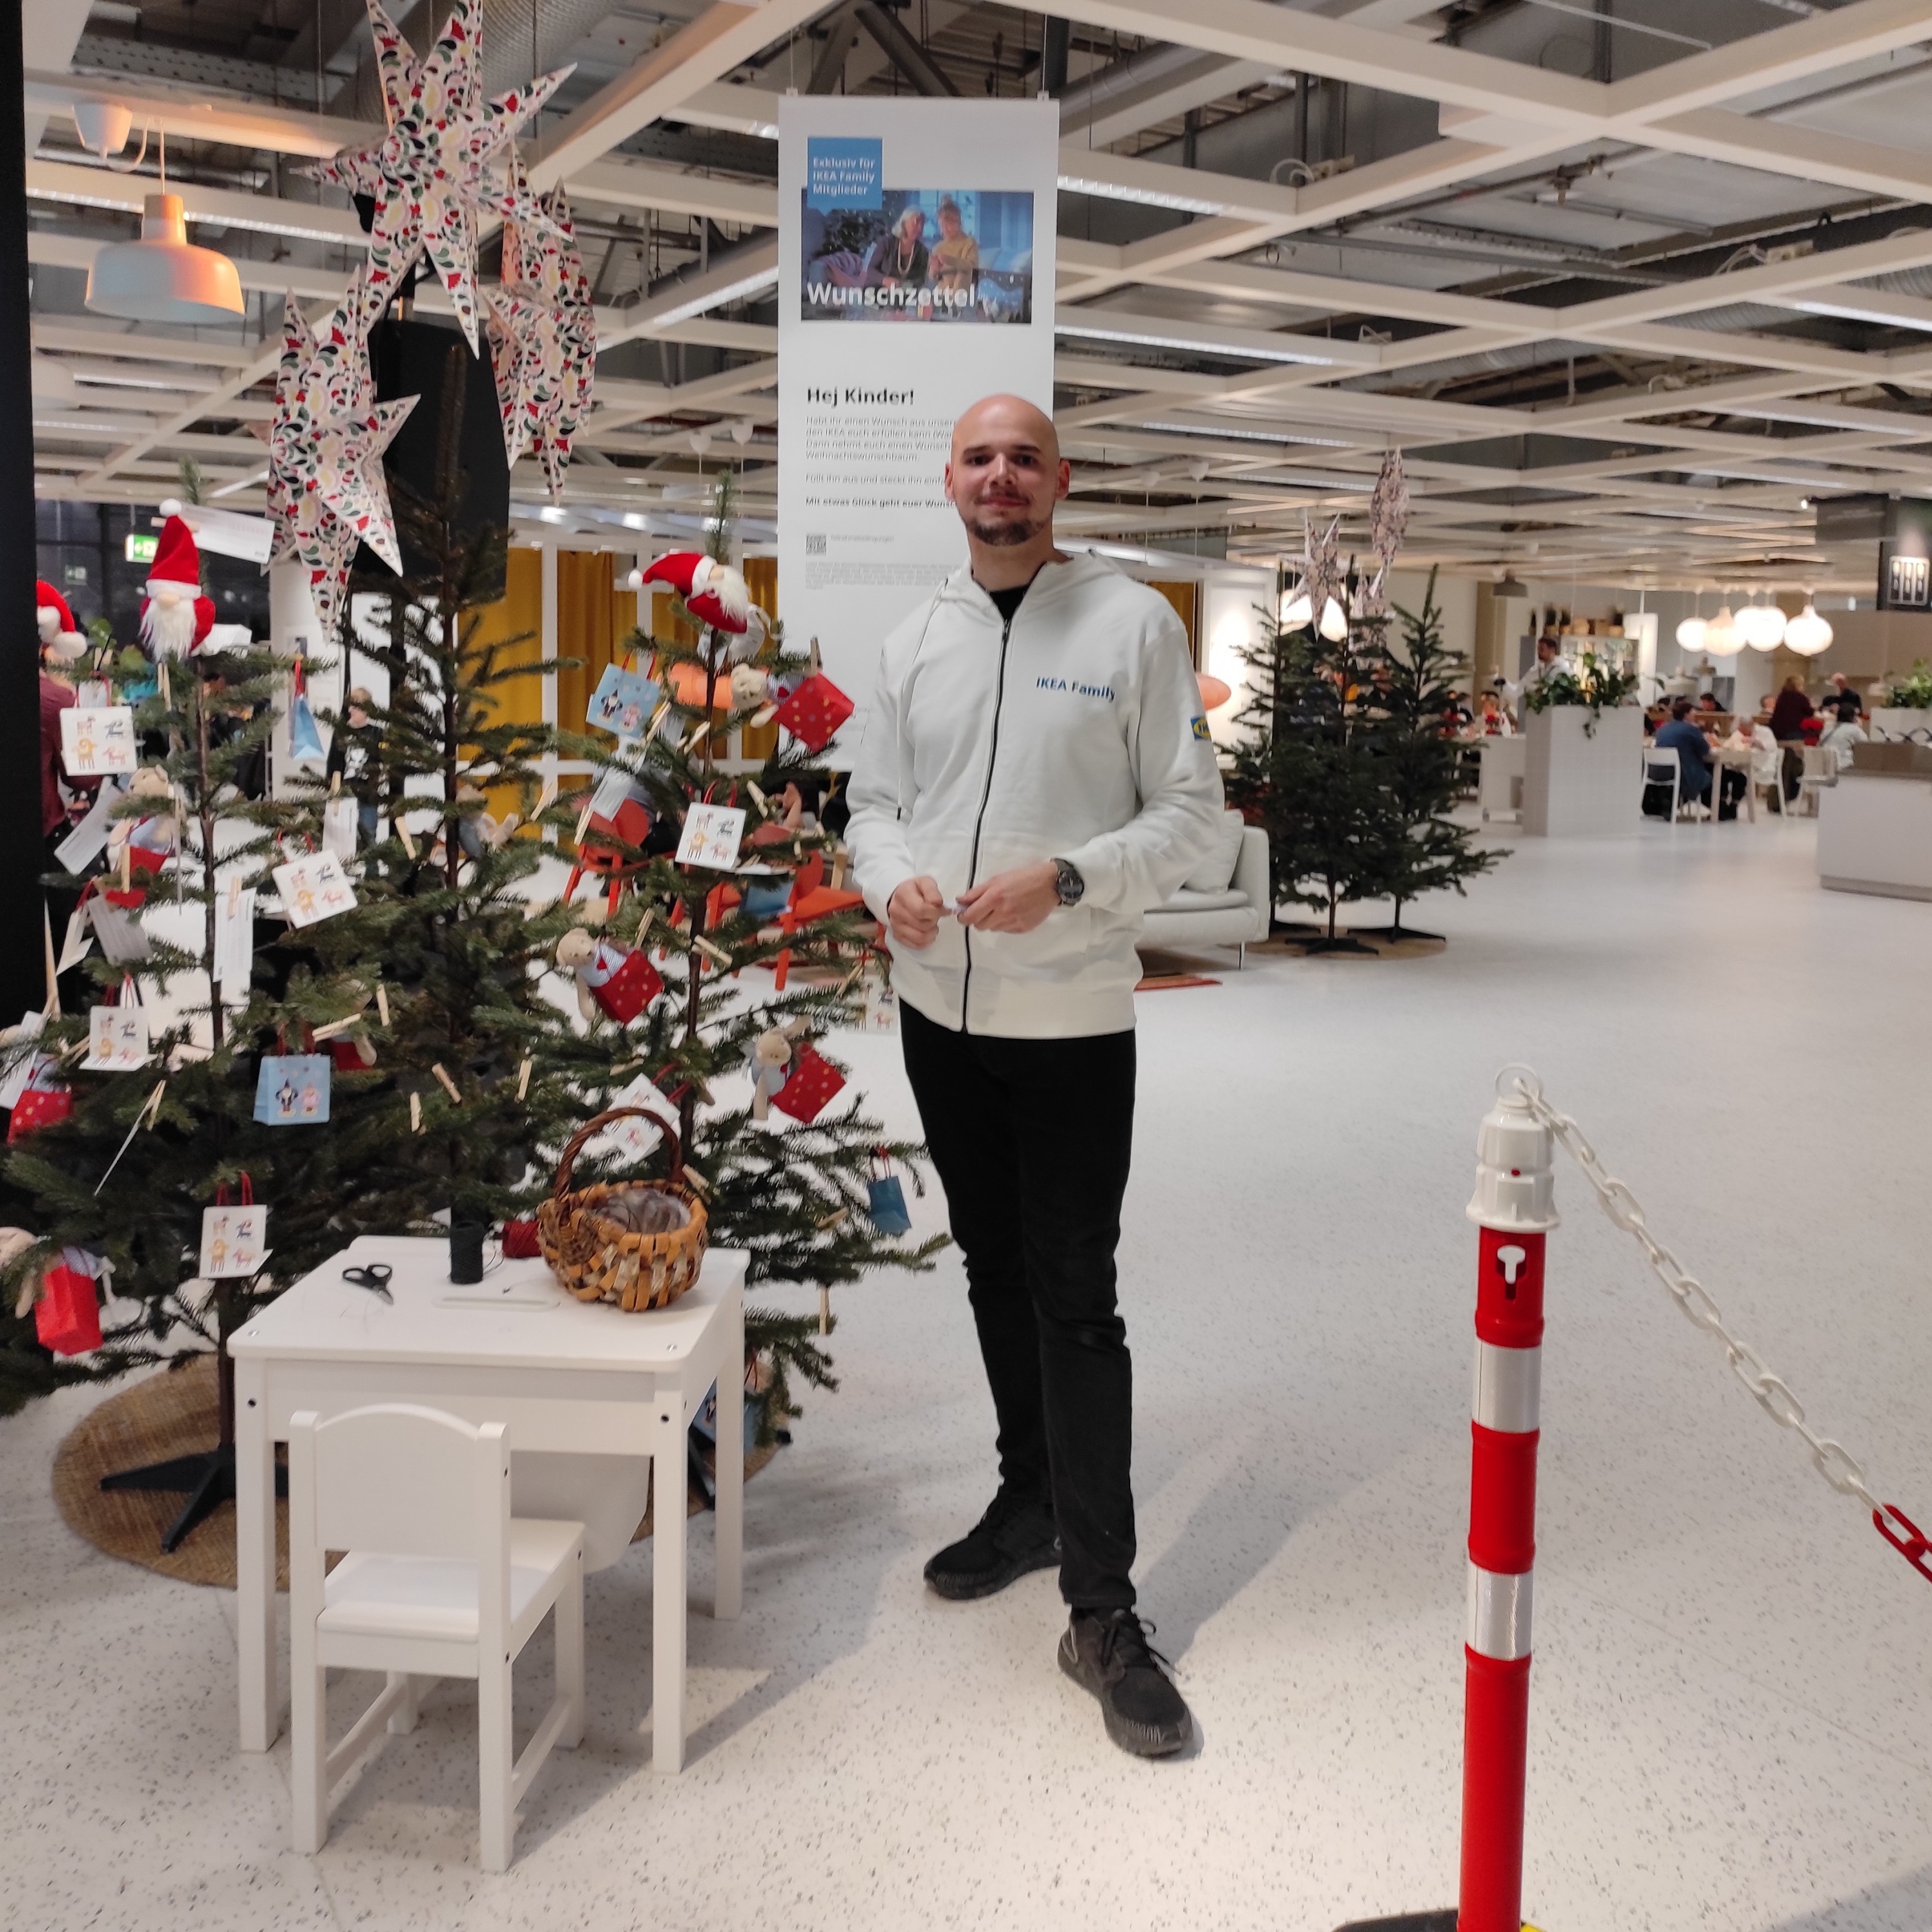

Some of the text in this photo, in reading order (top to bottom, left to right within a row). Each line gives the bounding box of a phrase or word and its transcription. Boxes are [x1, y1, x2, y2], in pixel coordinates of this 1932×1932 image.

[814, 157, 874, 169] Exklusiv für
[814, 171, 874, 184] IKEA Family
[814, 184, 867, 197] Mitglieder
[807, 282, 975, 308] Wunschzettel
[808, 386, 914, 409] Hej Kinder!
[1036, 676, 1115, 702] IKEA Family
